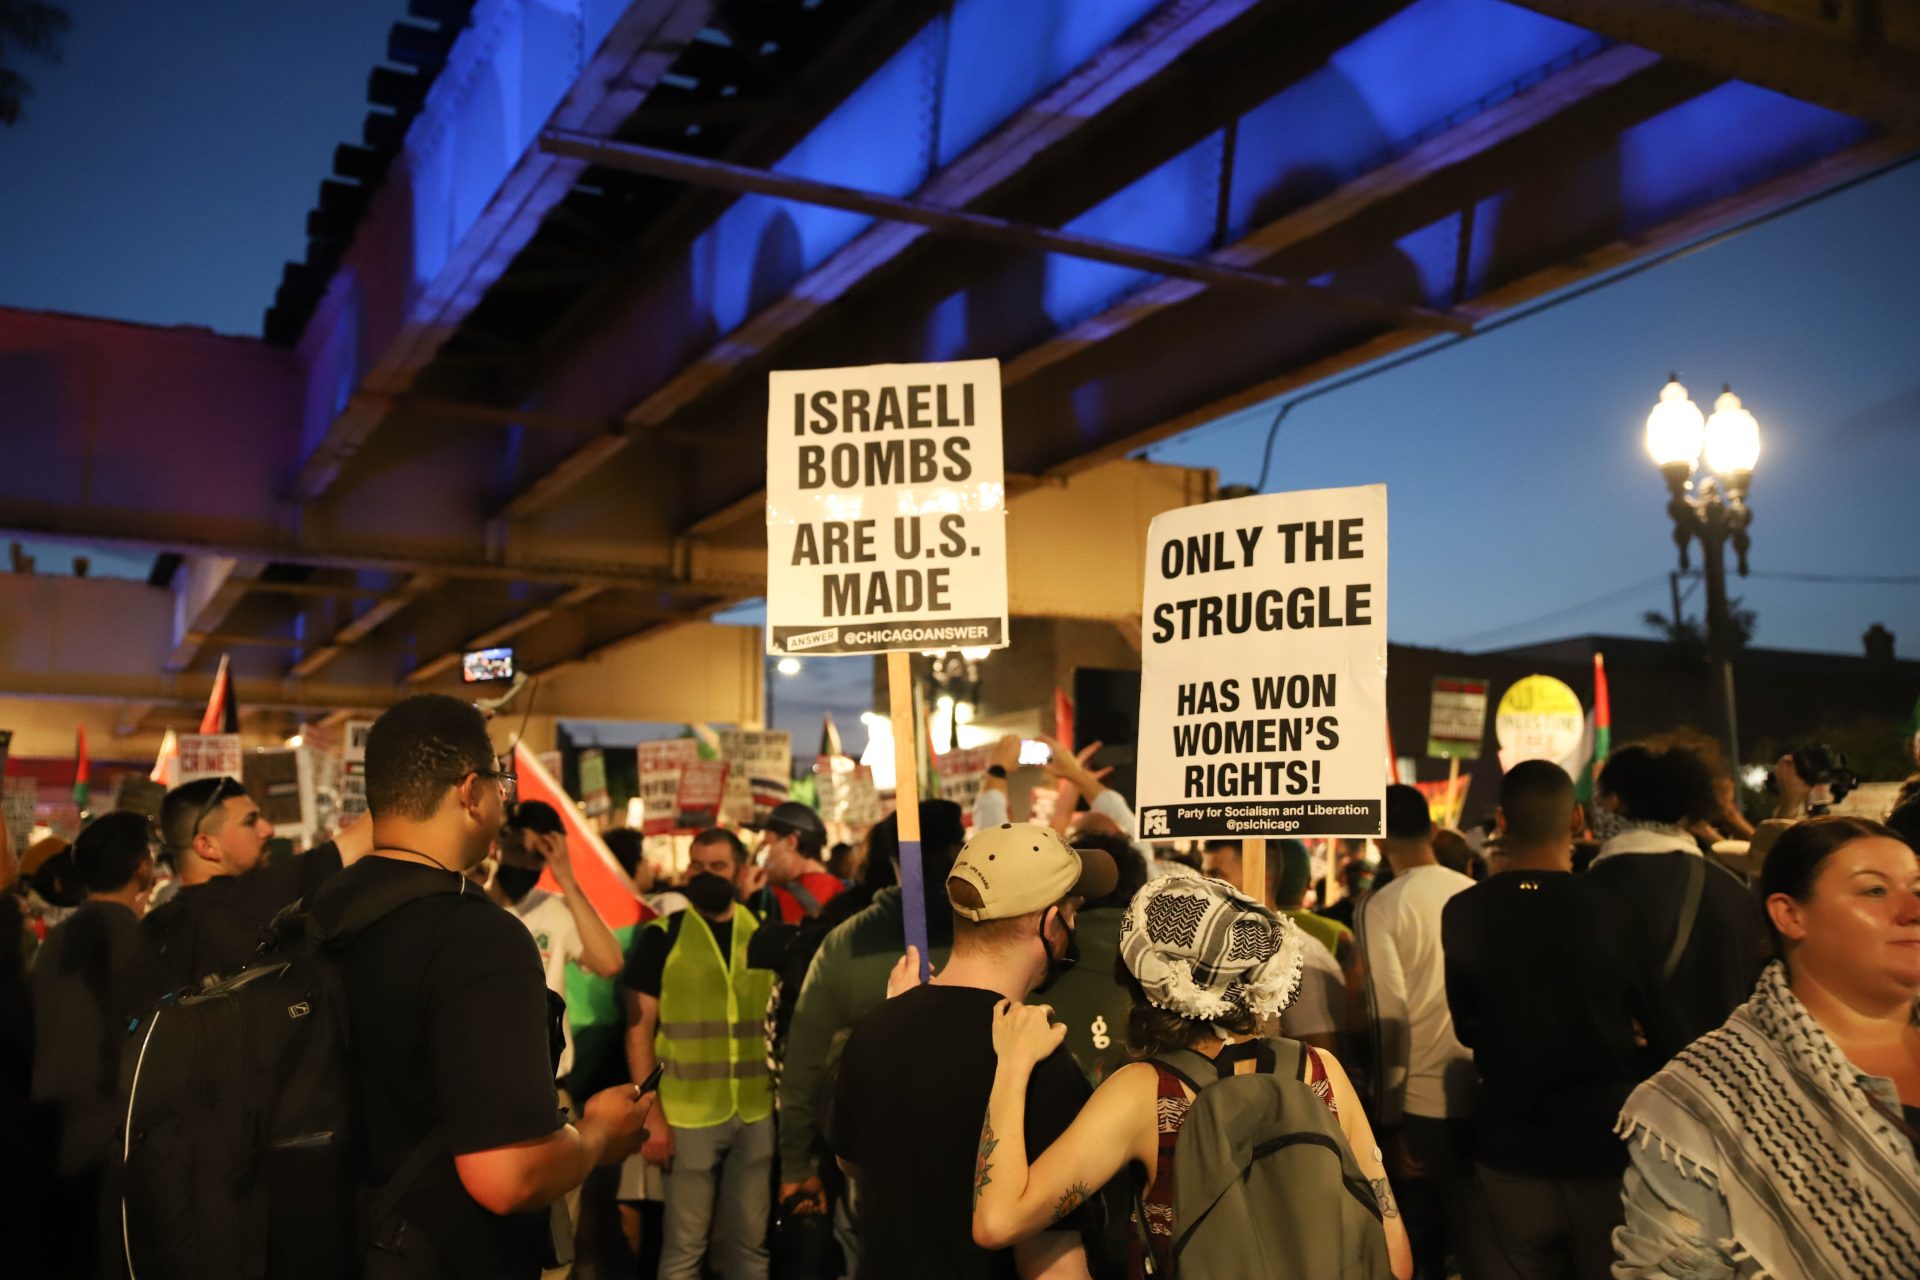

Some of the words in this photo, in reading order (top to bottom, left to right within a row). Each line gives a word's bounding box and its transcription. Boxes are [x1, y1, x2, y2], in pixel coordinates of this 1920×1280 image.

[794, 383, 975, 436] ISRAELI
[798, 436, 972, 490] BOMBS
[791, 519, 876, 566] ARE
[894, 514, 981, 560] U.S.
[1160, 525, 1264, 580] ONLY
[1277, 517, 1364, 564] THE
[822, 567, 952, 618] MADE
[1152, 583, 1372, 644] STRUGGLE
[790, 631, 835, 649] ANSWER
[844, 626, 989, 645] @CHICAGOANSWER
[1177, 678, 1240, 717] HAS
[1252, 673, 1337, 711] WON
[1173, 715, 1340, 758] WOMEN'S
[1184, 760, 1321, 799] RIGHTS!
[1143, 815, 1171, 836] PSL
[1177, 808, 1204, 820] Party
[1206, 807, 1222, 817] for
[1224, 805, 1280, 817] Socialism
[1282, 804, 1304, 816] and
[1307, 804, 1369, 815] Liberation
[1226, 818, 1300, 832] @pslchicago
